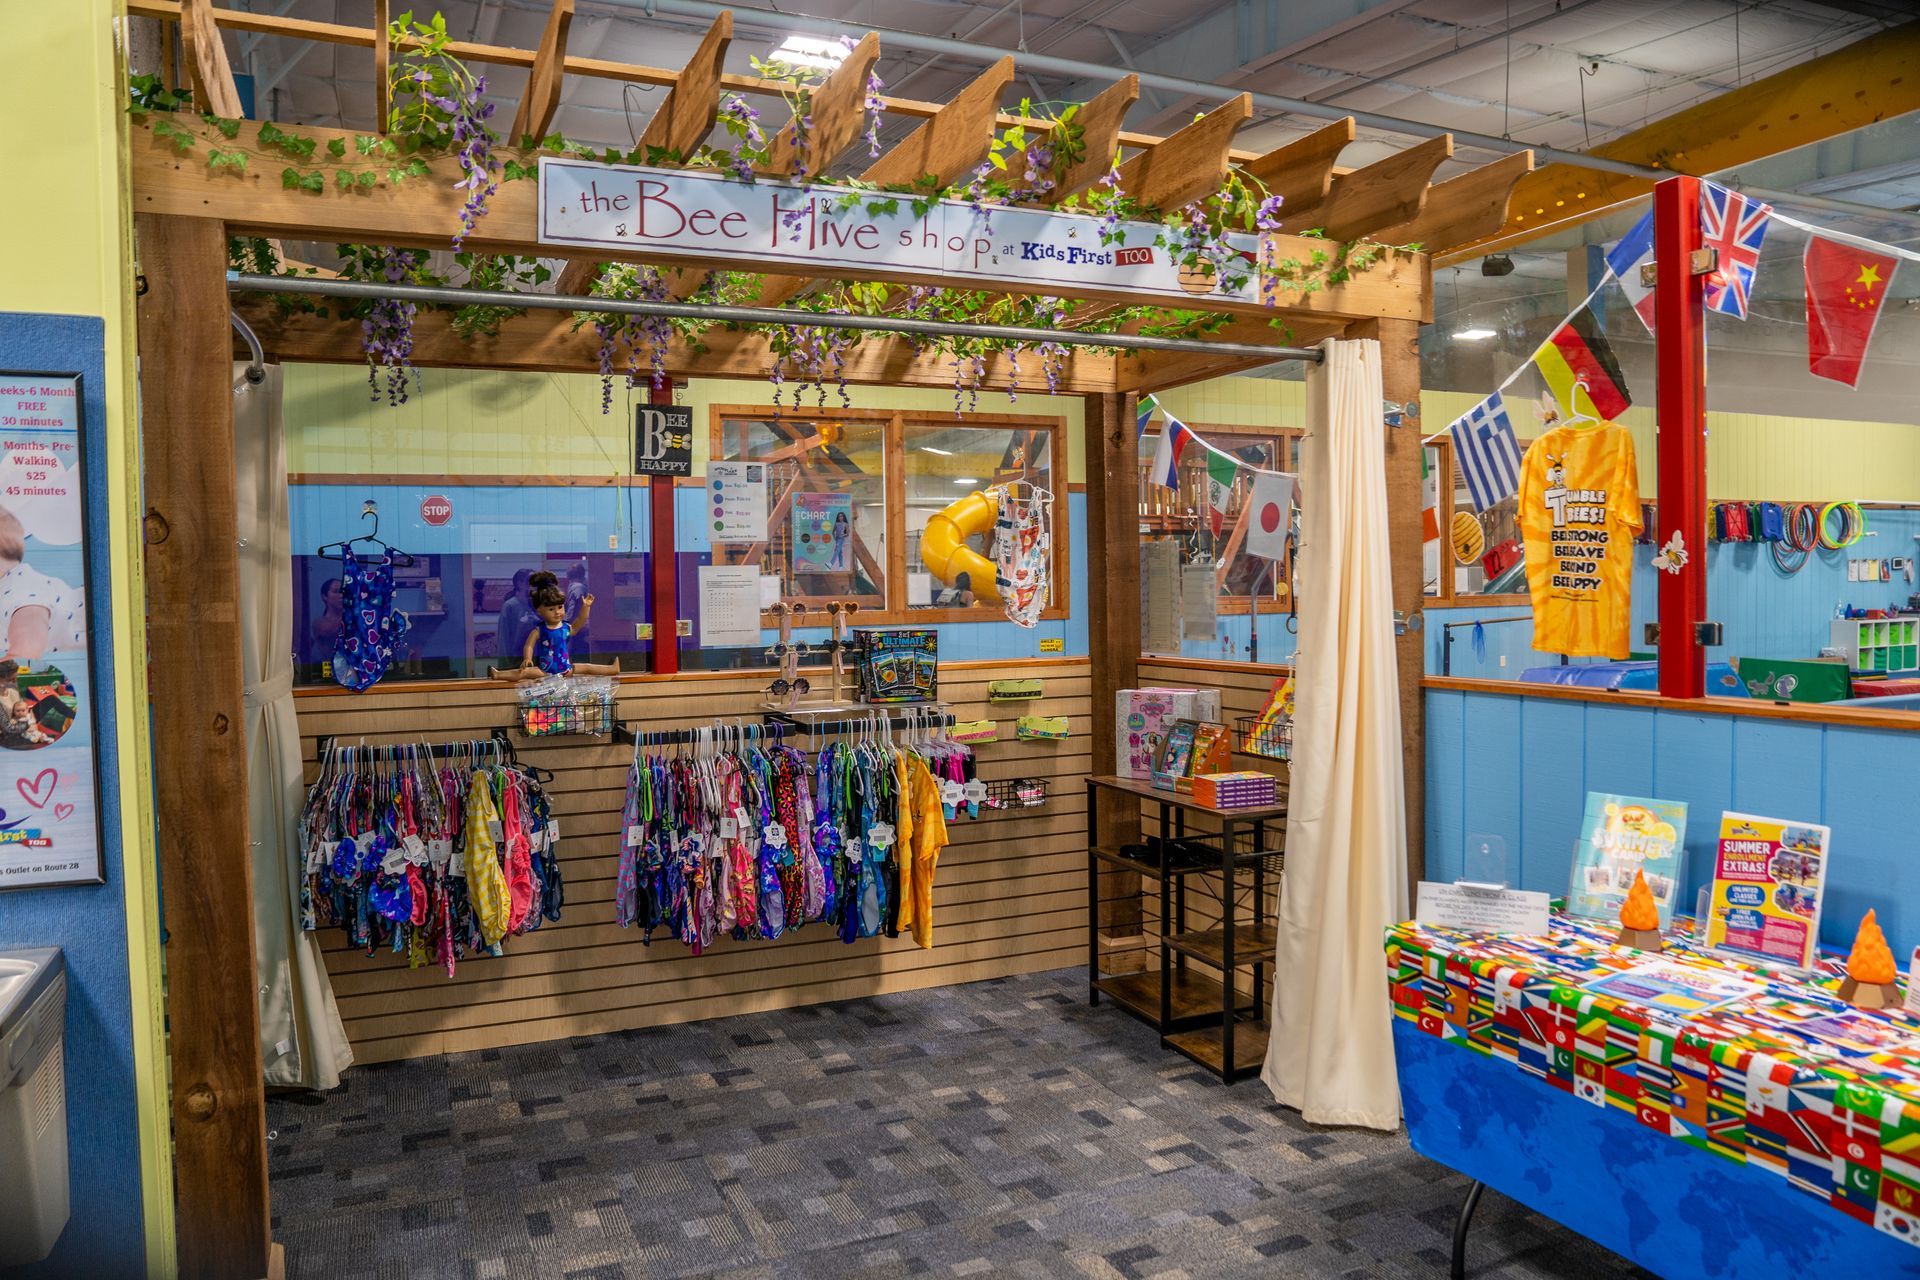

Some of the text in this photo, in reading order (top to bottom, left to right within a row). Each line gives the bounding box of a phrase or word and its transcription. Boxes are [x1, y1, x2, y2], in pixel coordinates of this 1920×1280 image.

[580, 180, 631, 213] the
[634, 179, 749, 239] Bee
[771, 193, 881, 251] Hive
[898, 215, 992, 269] shop
[1002, 244, 1015, 256] at
[1119, 248, 1150, 264] TOO
[0, 385, 76, 397] eeks-6 Month
[17, 401, 47, 411] FREE
[2, 415, 64, 427] 30 minutes
[639, 409, 689, 460] BEE
[52, 441, 75, 451] Pre-
[13, 455, 58, 468] Walking
[639, 459, 689, 472] HAPPY
[26, 471, 47, 481] $25
[6, 486, 67, 496] 45 minutes
[423, 505, 450, 516] STOP
[801, 511, 831, 521] CHART
[882, 635, 926, 645] ULTIMATE
[1723, 840, 1771, 855] SUMMER
[6, 865, 30, 875] Outlet
[45, 863, 67, 872] Route
[69, 862, 79, 870] 28
[1722, 860, 1767, 874] EXTRAS!
